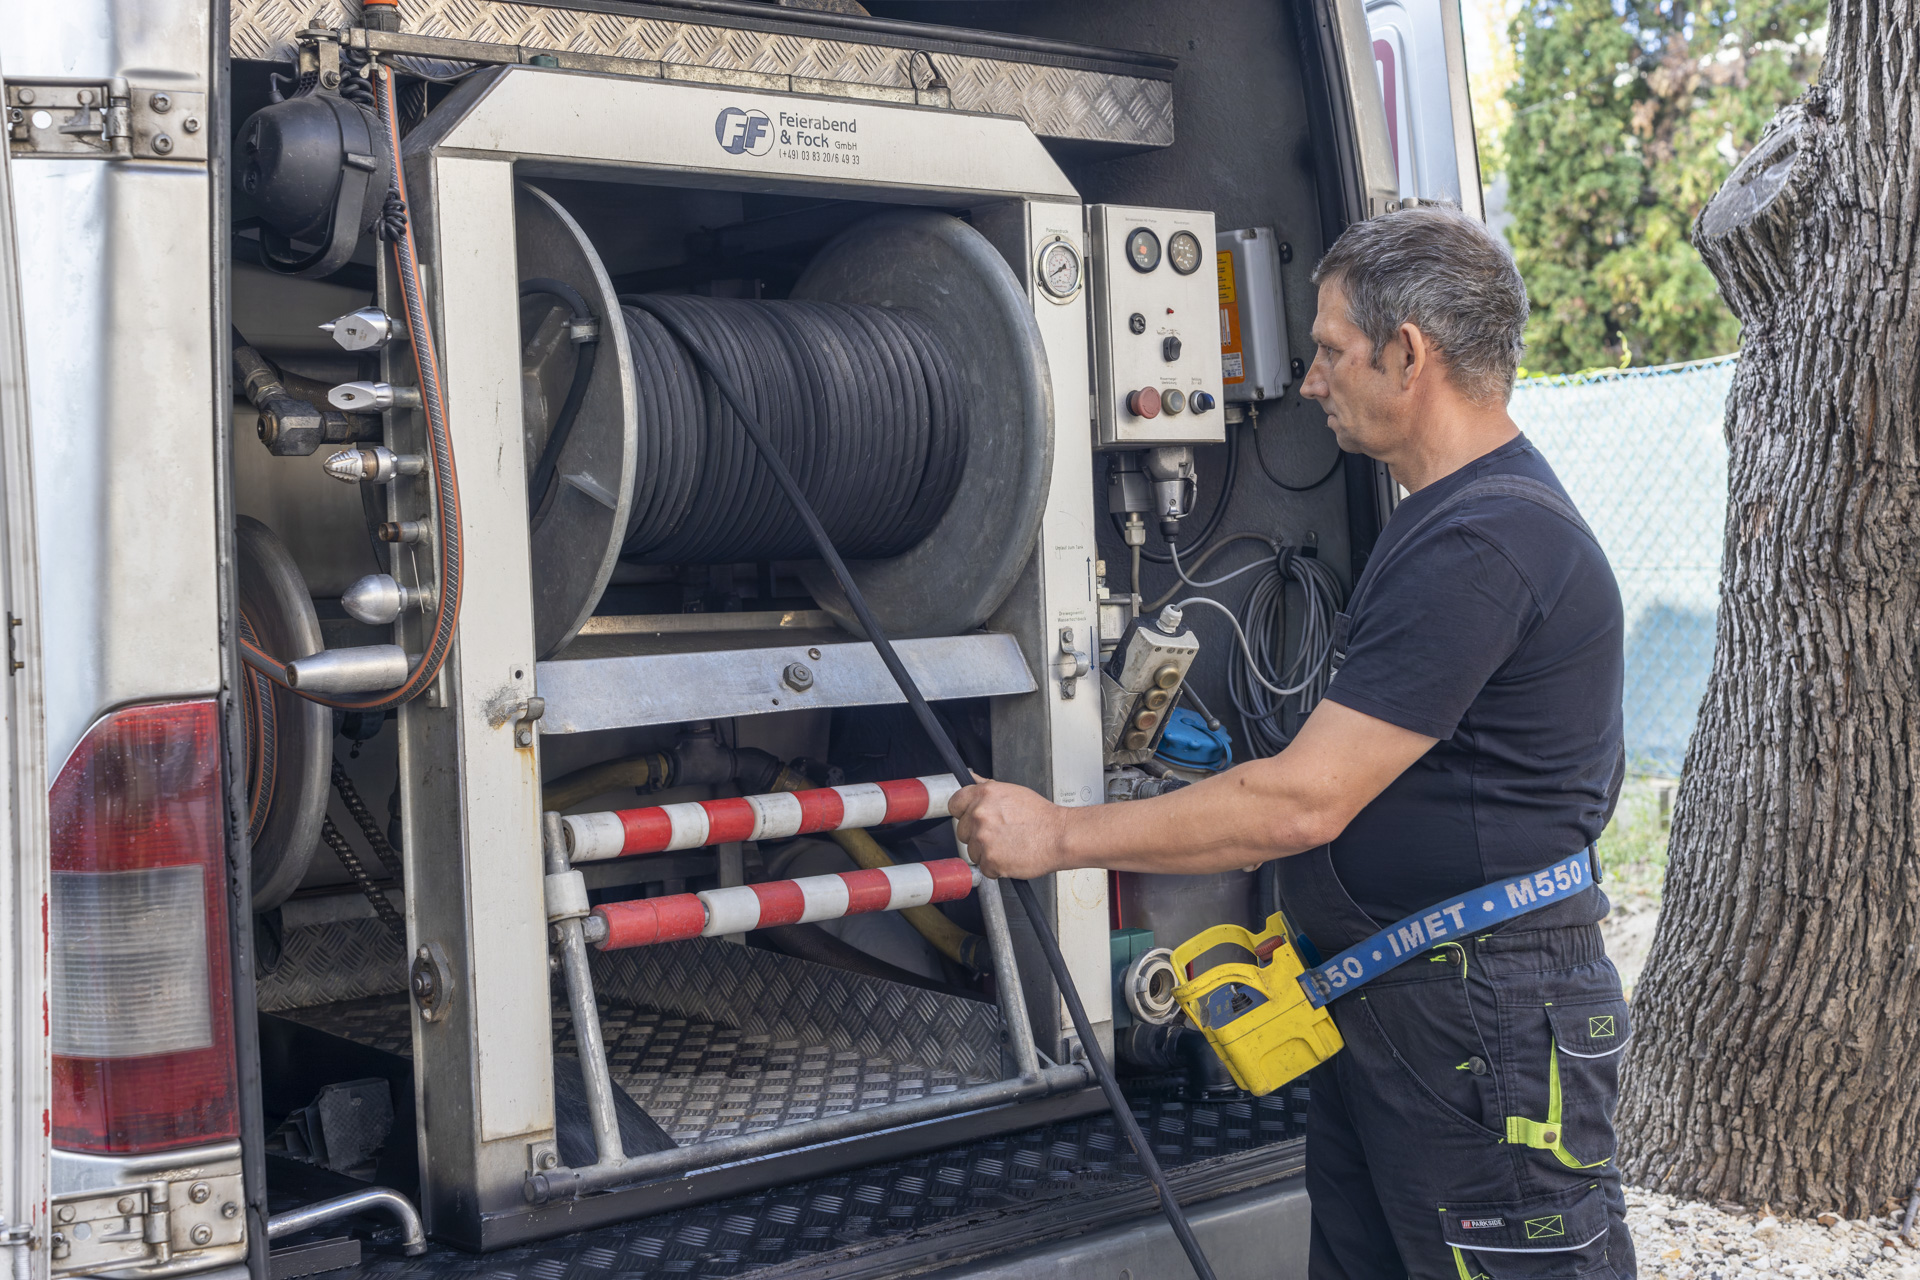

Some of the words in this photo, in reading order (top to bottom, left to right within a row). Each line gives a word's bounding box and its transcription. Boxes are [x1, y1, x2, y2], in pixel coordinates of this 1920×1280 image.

[779, 111, 857, 133] Feierabend
[780, 129, 792, 146] &
[796, 131, 829, 149] Fock
[834, 140, 858, 151] GmbH
[779, 148, 799, 161] (+49)
[801, 150, 810, 161] 03
[812, 151, 821, 162] 83
[822, 152, 840, 164] 20/6
[841, 153, 850, 164] 49
[852, 154, 860, 165] 33
[1387, 902, 1467, 958] IMET
[1504, 860, 1582, 909] M550
[1471, 1219, 1503, 1227] PARKSIDE
